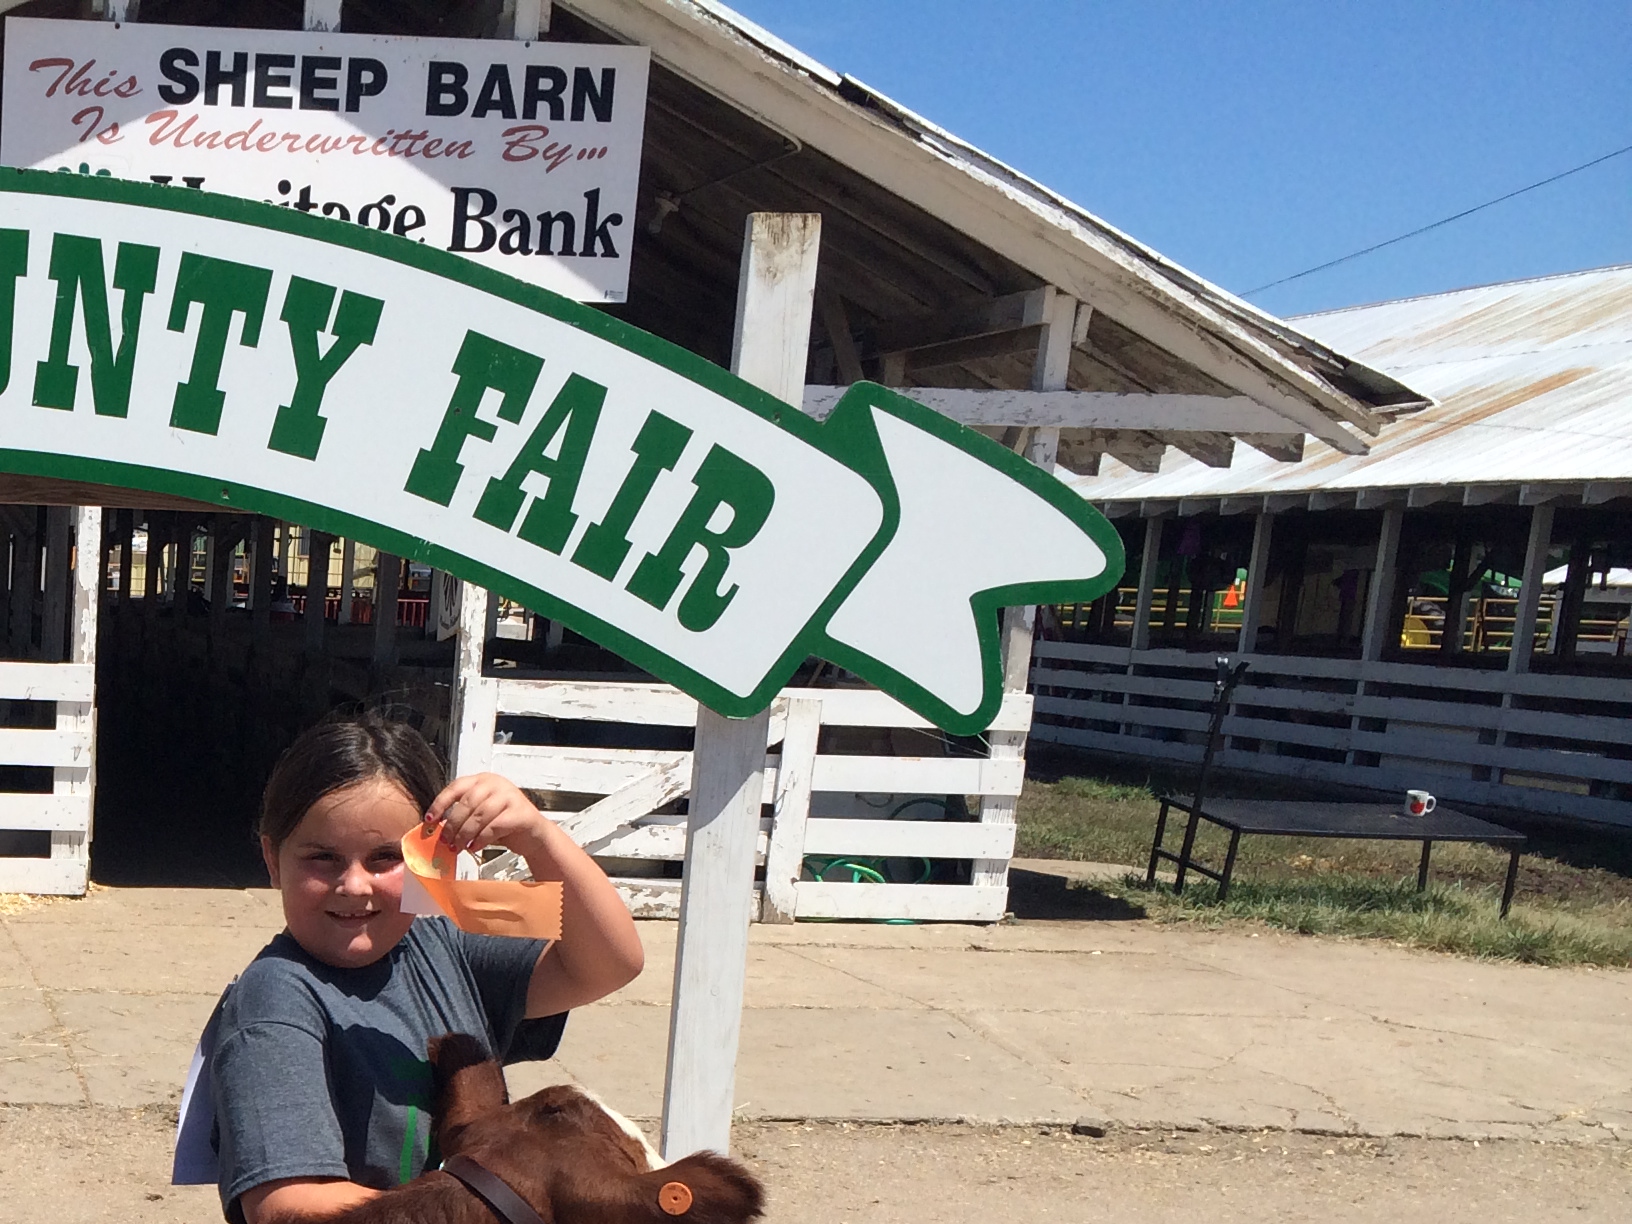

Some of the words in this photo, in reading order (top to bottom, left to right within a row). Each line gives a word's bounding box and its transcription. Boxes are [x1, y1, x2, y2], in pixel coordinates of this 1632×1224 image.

[28, 57, 143, 98] This
[157, 47, 389, 113] SHEEP
[425, 60, 616, 123] BARN
[71, 105, 125, 145] Is
[145, 109, 475, 160] Underwritten
[501, 124, 608, 174] By...
[446, 186, 623, 259] Bank
[406, 330, 776, 631] FAIR
